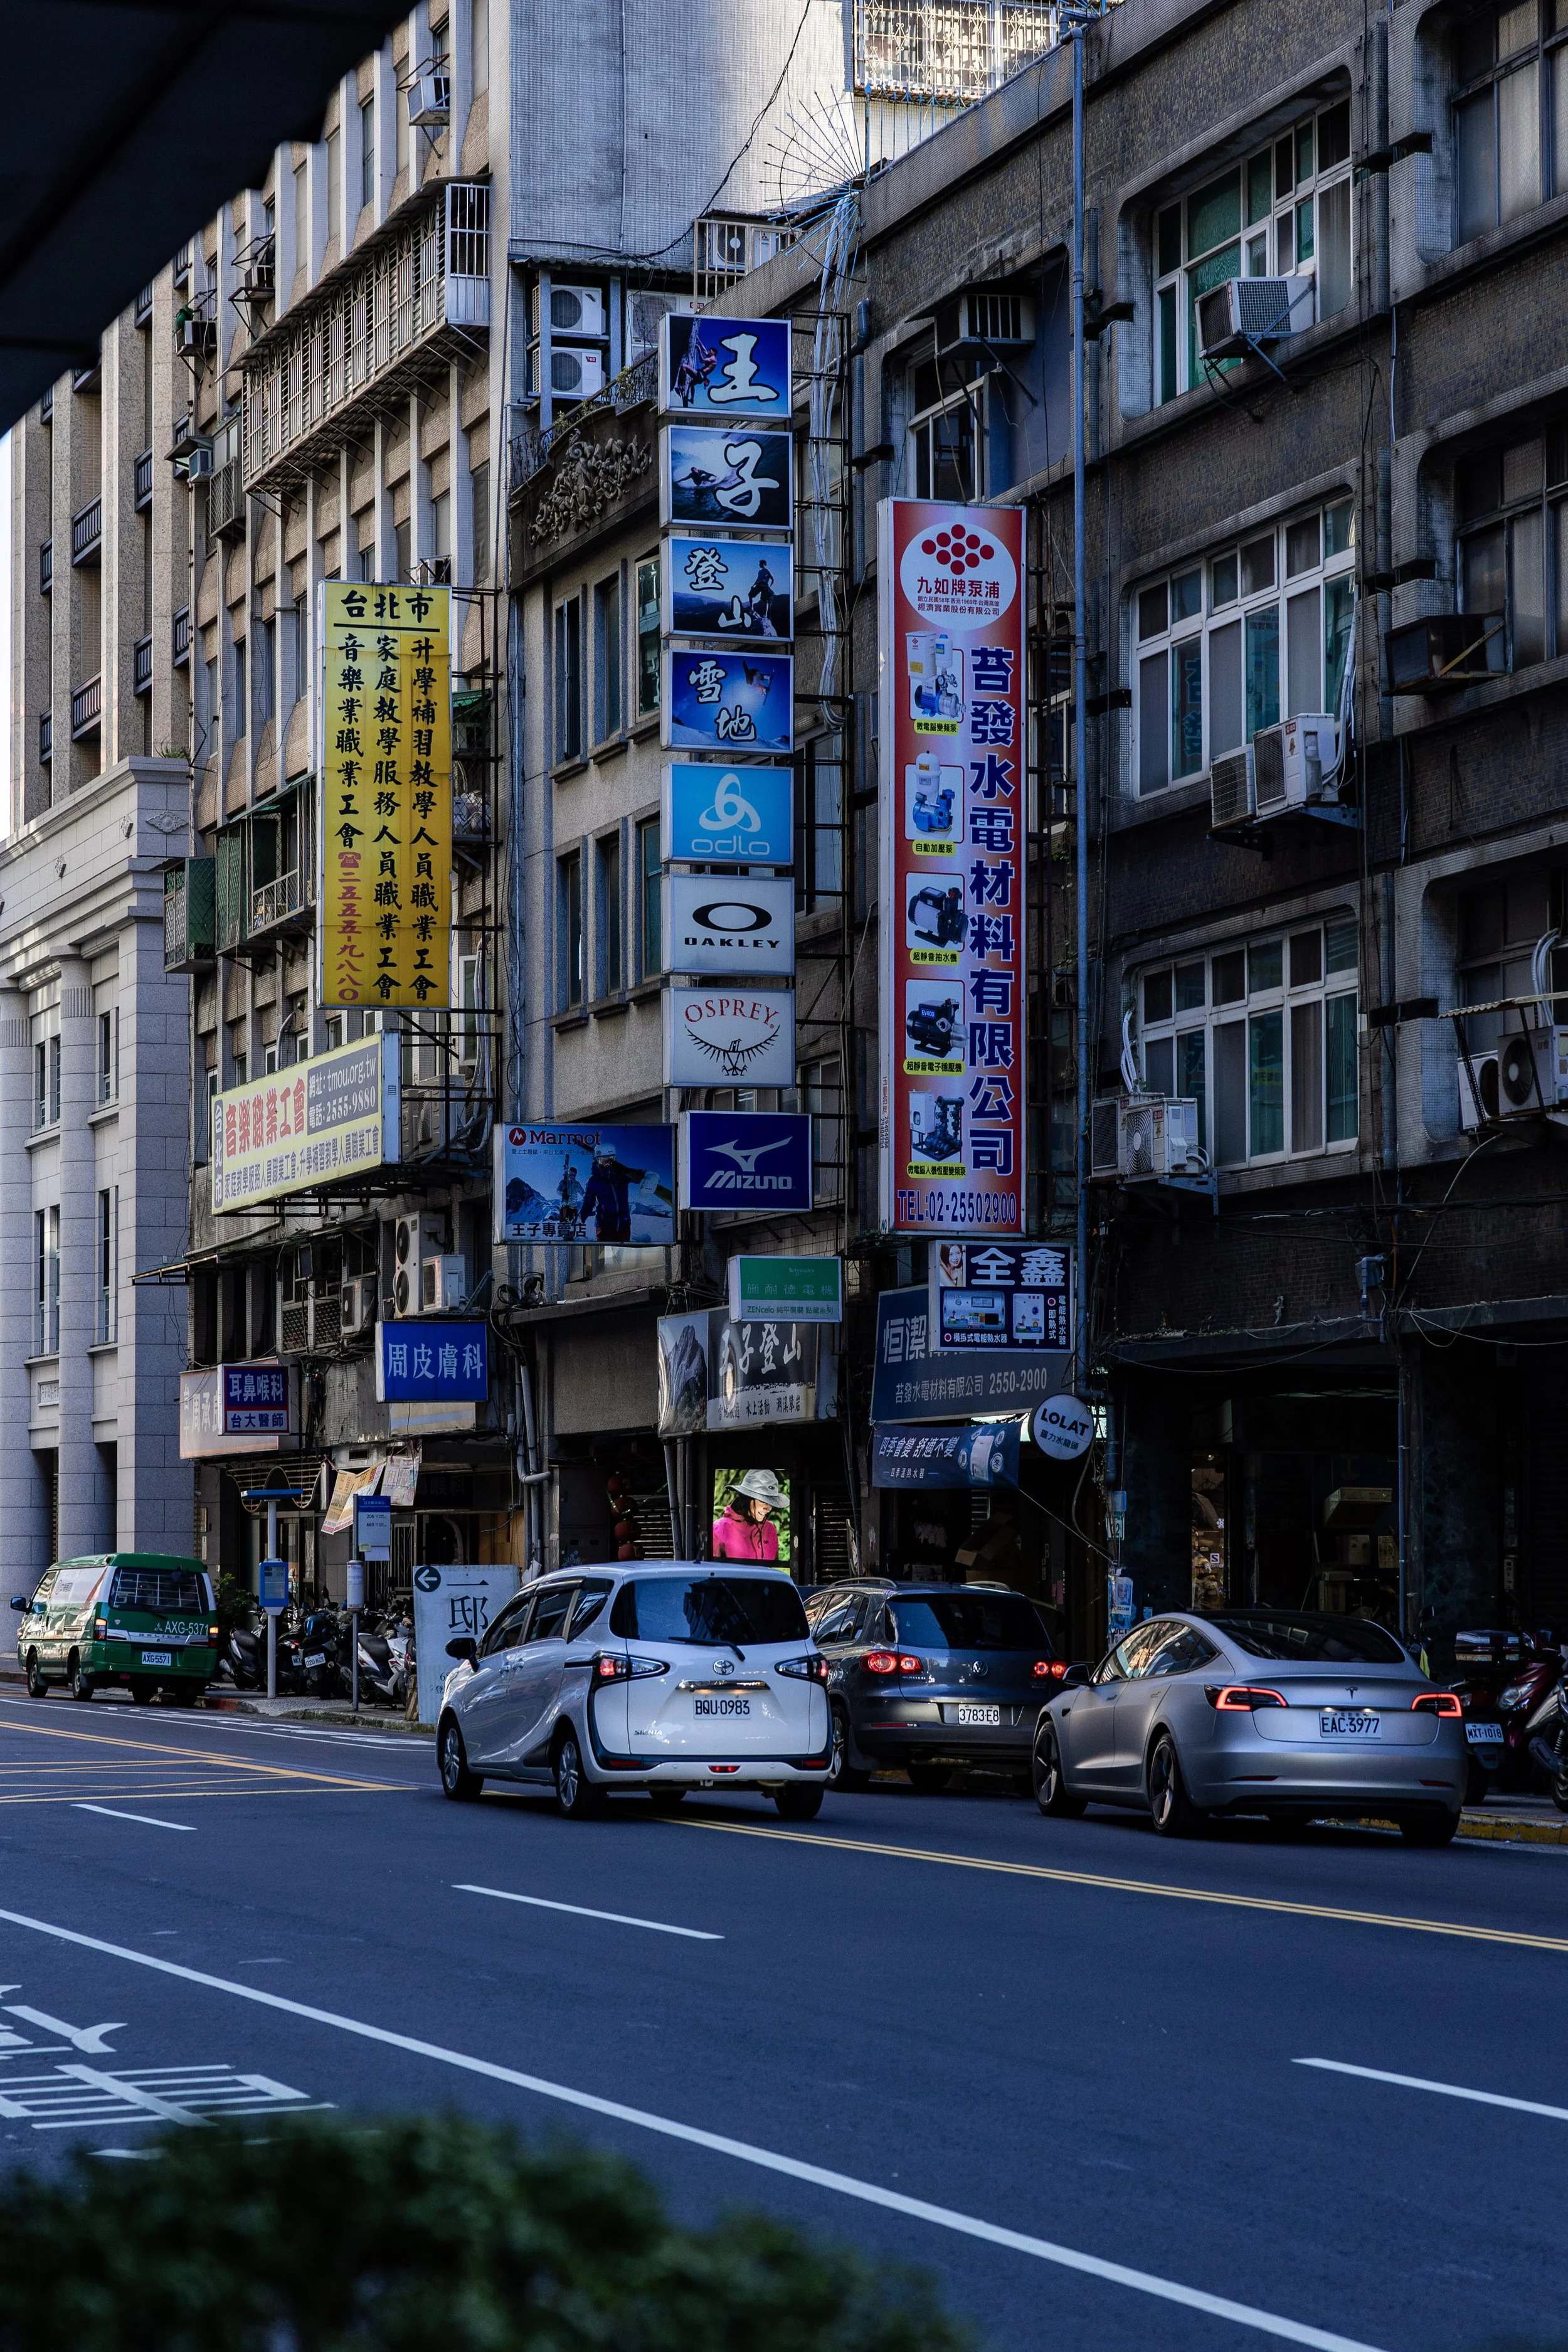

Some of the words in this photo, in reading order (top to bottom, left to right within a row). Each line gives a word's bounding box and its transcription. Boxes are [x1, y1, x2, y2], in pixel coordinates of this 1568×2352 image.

[708, 332, 780, 403] 王
[716, 440, 779, 517] 子
[917, 576, 1000, 599] 九如牌泵浦
[340, 589, 434, 623] 台北市
[689, 659, 757, 741] 雪地
[334, 633, 365, 849] 音樂業職業工會
[372, 635, 403, 1000] 家庭教學服務人員職業工會
[408, 635, 440, 1002] 升學補習教學人員職業工會
[691, 834, 770, 856] odlo
[916, 842, 953, 854] 自動加壓泵
[968, 645, 1015, 1177] 苔發水電材料有限公司
[684, 937, 780, 949] OAKLEY
[684, 999, 780, 1026] OSPREY
[921, 1009, 935, 1017] EV400
[225, 1077, 306, 1158] 音樂職業工會
[529, 1130, 601, 1145] Marmot
[511, 1222, 587, 1238] 王子專賣店
[970, 1247, 1066, 1287] 全鑫
[746, 1284, 834, 1296] 施耐德電機
[1048, 1309, 1057, 1340] 即熱式
[388, 1342, 484, 1380] 周皮膚科
[228, 1373, 283, 1402] 耳鼻喉科
[988, 1367, 1047, 1396] 2550-2900
[230, 1412, 284, 1428] 台大醫師
[1041, 1407, 1089, 1436] LOLAT
[164, 1621, 209, 1636] AXG-5371
[142, 1654, 170, 1664] AXG-5371
[695, 1699, 750, 1715] BQU-0983
[959, 1708, 1000, 1722] 3783-E8
[1321, 1717, 1380, 1733] EAC-3977
